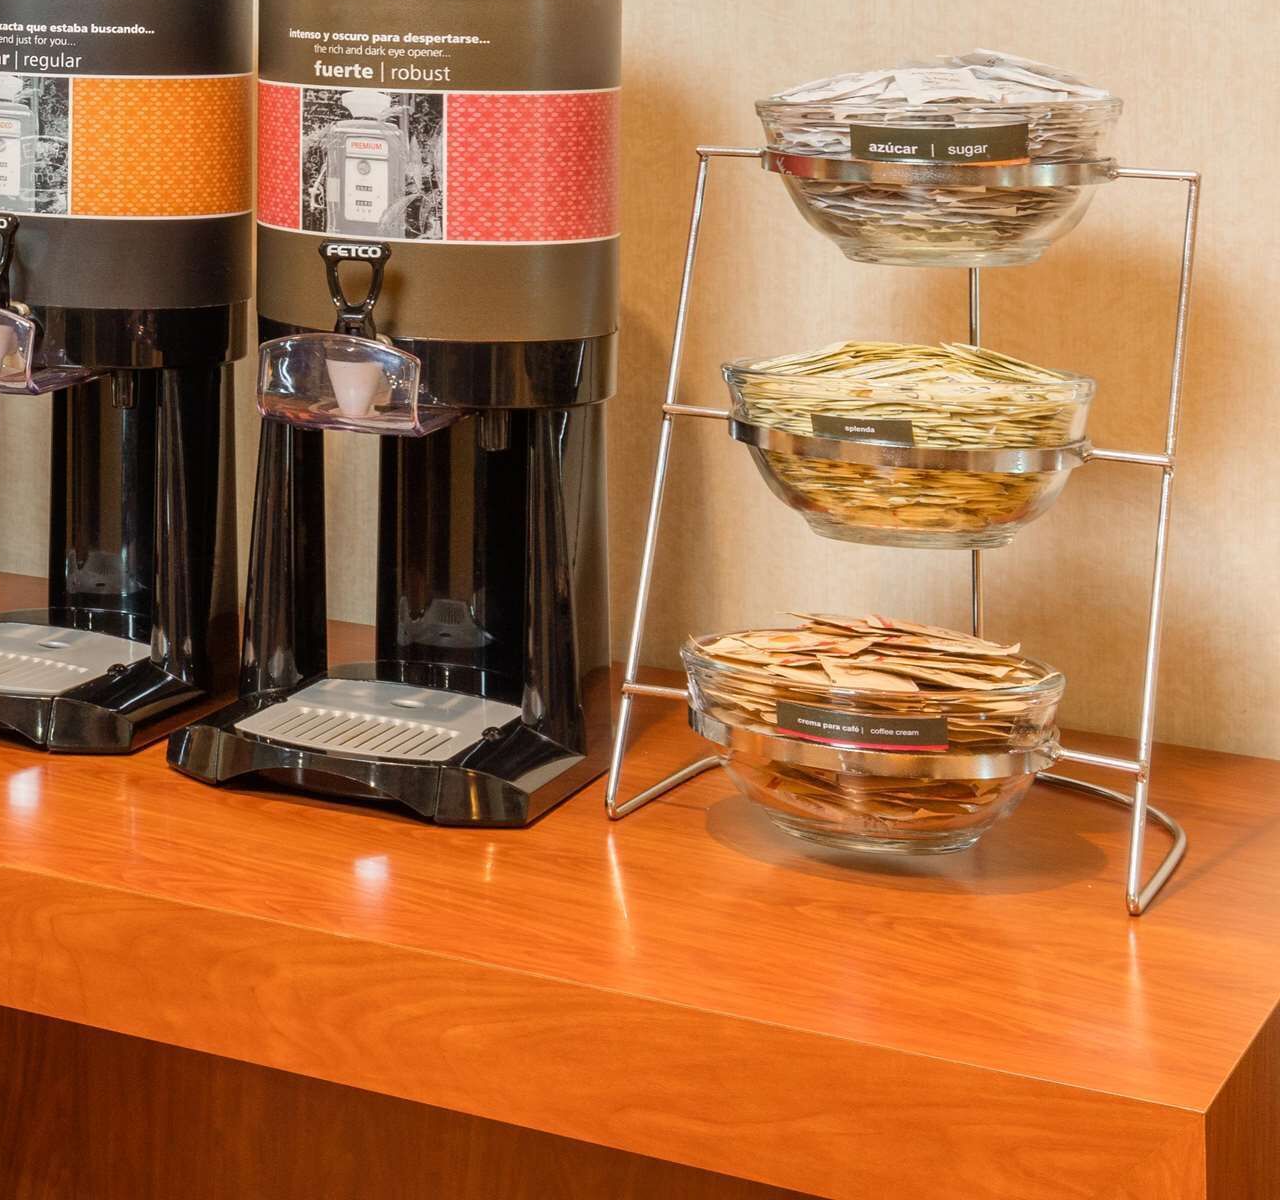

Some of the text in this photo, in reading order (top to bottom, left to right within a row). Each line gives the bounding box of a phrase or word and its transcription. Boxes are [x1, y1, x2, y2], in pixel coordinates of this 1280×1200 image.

[26, 24, 47, 34] que
[49, 23, 88, 33] estaba
[91, 24, 155, 34] buscando...
[15, 34, 32, 46] just
[34, 35, 48, 45] for
[49, 37, 76, 47] you...
[289, 28, 490, 45] intenso y oscuro para despertarse...
[314, 44, 327, 54] the
[328, 44, 343, 54] rich
[345, 46, 363, 56] and
[365, 46, 385, 56] dark
[388, 49, 405, 58] eye
[23, 52, 82, 70] regular
[314, 60, 451, 81] fuerte robust
[351, 141, 382, 150] PREMIUM
[868, 142, 988, 158] azúcar sugar
[327, 245, 382, 258] FETCO
[844, 425, 875, 433] splenda
[797, 717, 821, 728] crema
[823, 722, 840, 730] para
[870, 727, 894, 736] coffee
